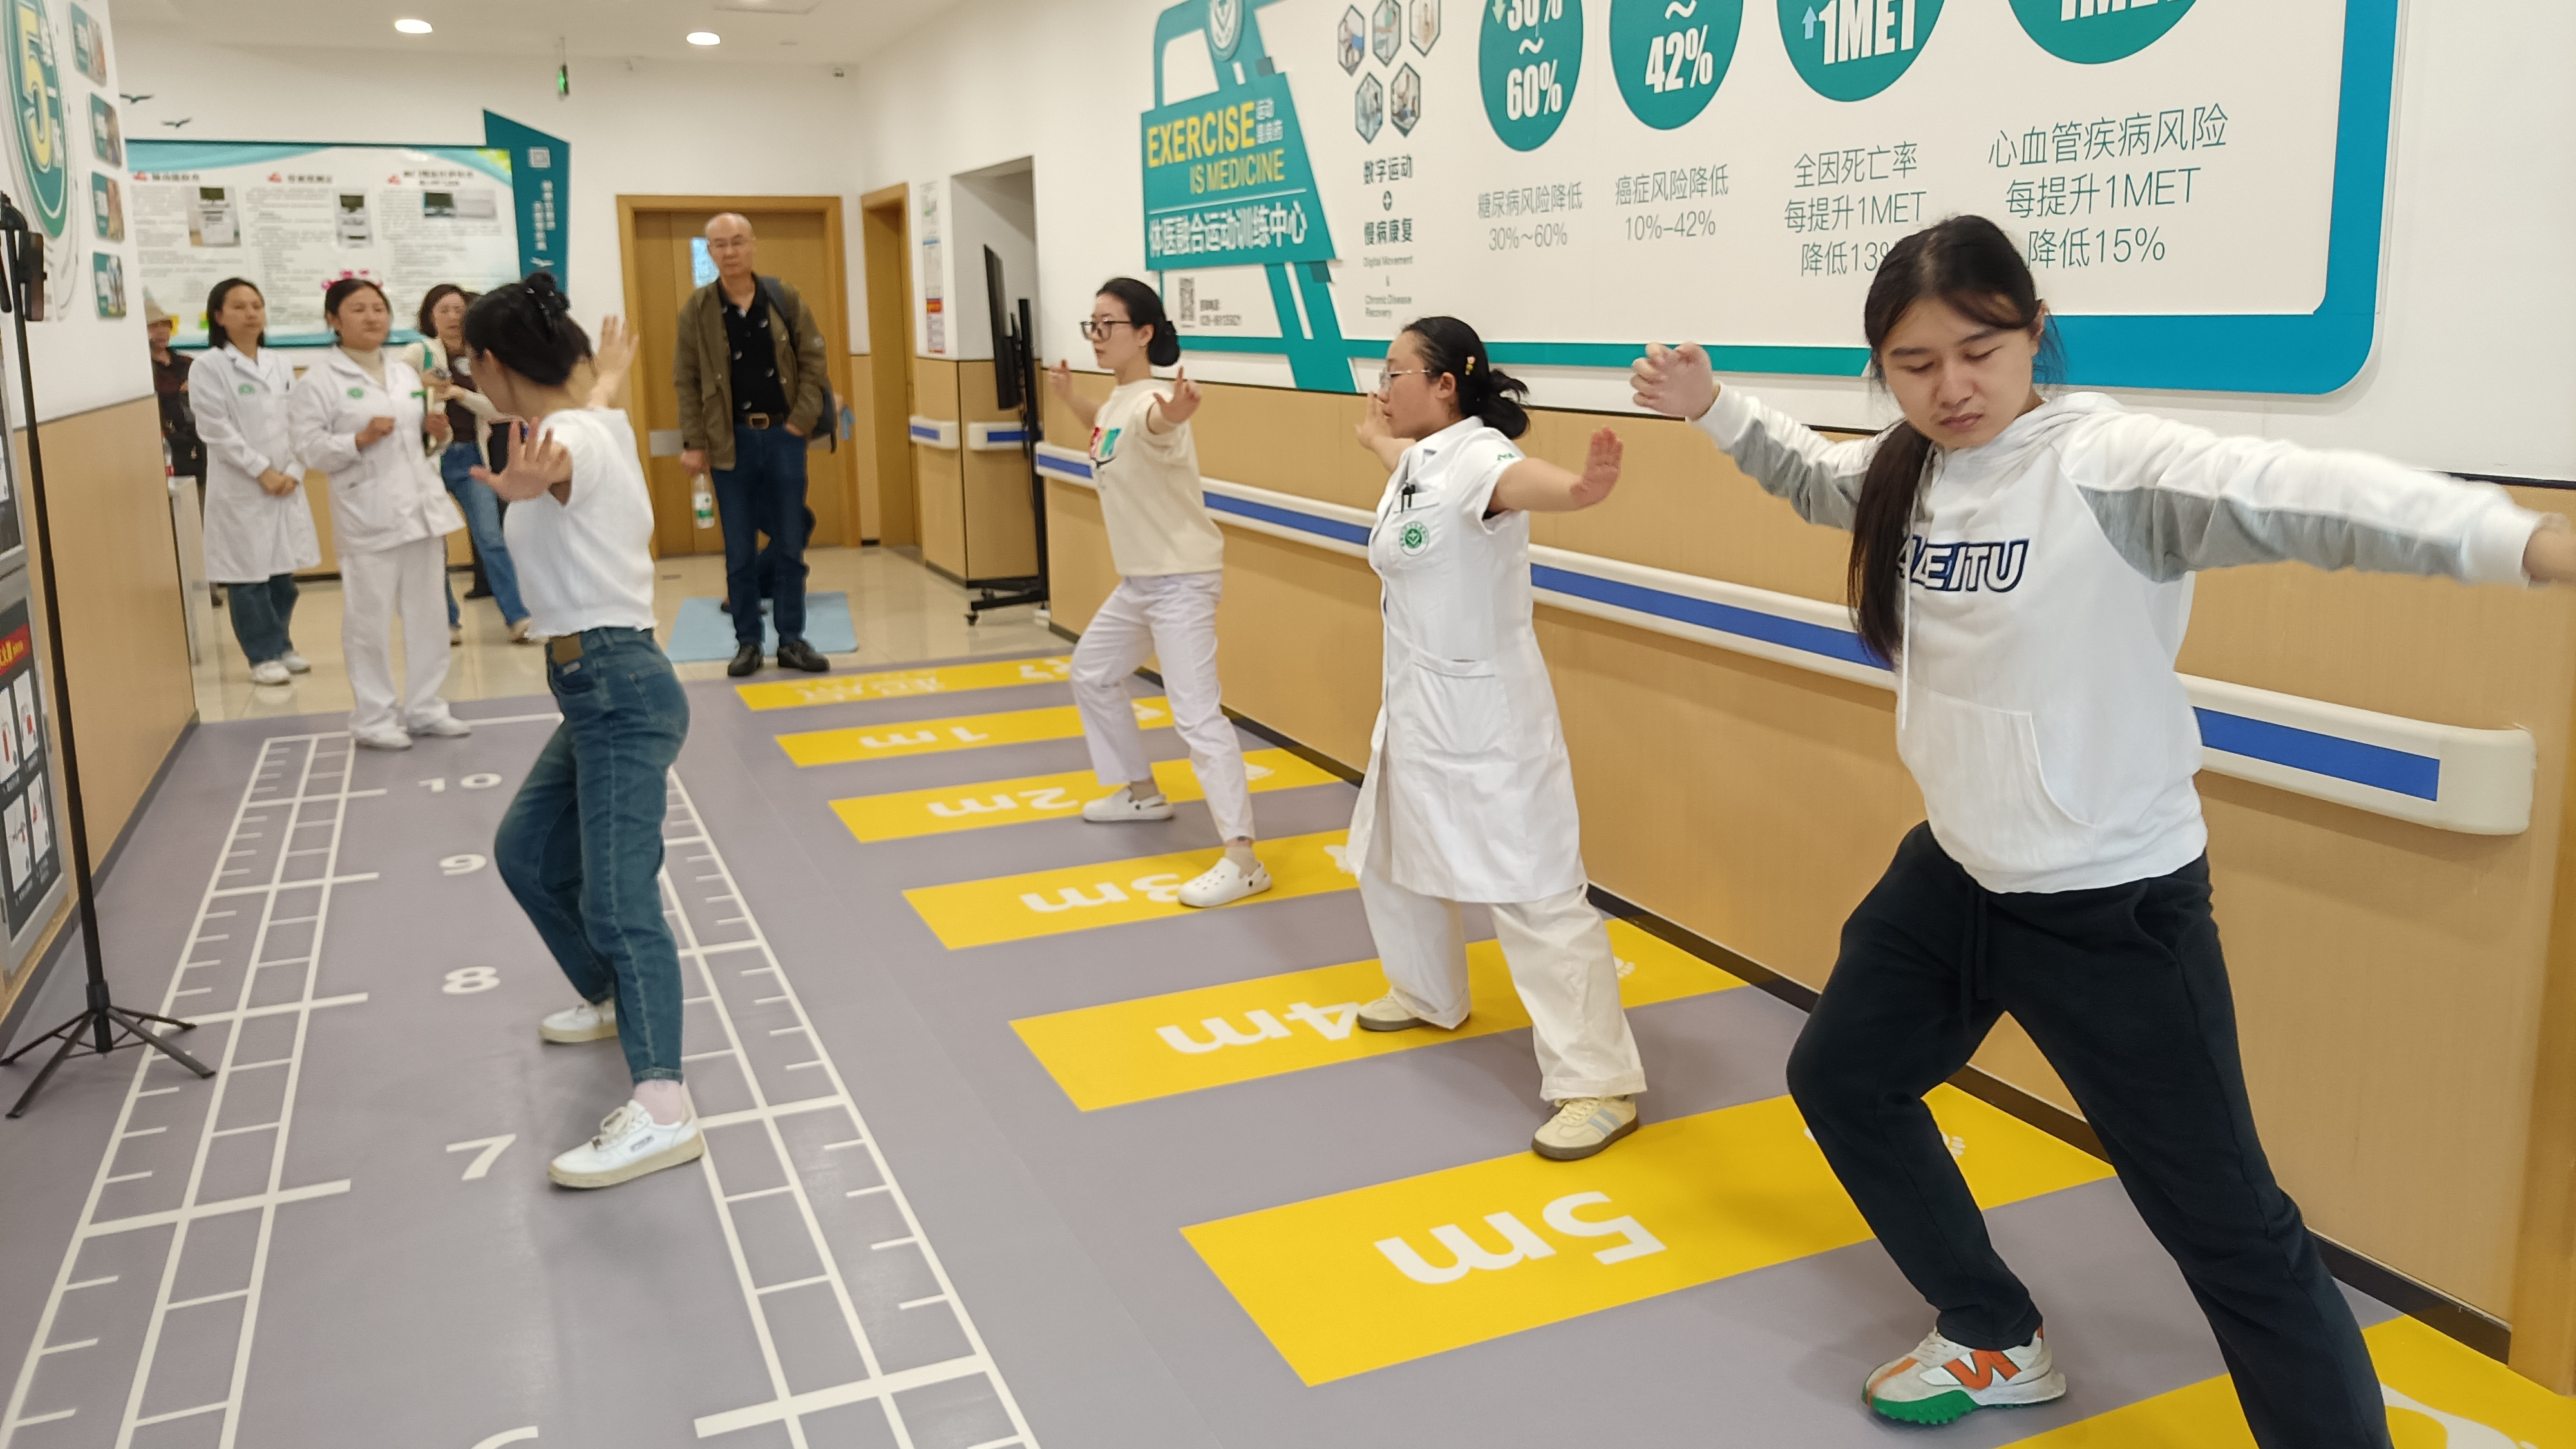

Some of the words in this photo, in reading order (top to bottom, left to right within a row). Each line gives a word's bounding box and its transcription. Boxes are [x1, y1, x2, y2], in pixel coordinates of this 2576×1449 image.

[1645, 24, 1714, 94] 42%
[1506, 58, 1563, 121] 60%
[1147, 100, 1255, 169] EXERCISE
[1988, 103, 2228, 168] 心血管疾病风险
[1189, 164, 1205, 194] IS
[1207, 148, 1285, 192] MEDICINE
[1363, 155, 1413, 185] 数字运动
[1615, 164, 1728, 206] 癌症风险降低
[1794, 140, 1918, 189] 全因死亡率
[1477, 181, 1583, 220] 糖尿病风险降低
[1784, 191, 1927, 233] 每提升1MET
[2005, 167, 2201, 219] 每提升1MET
[2027, 226, 2165, 269] 降低15%
[418, 773, 502, 793] 10
[927, 787, 1079, 817] 2m
[439, 854, 487, 876] 9
[1020, 874, 1180, 913] 3m
[442, 966, 500, 995] 8
[1156, 1001, 1361, 1054] 4m
[446, 1133, 516, 1181] 7
[1374, 1191, 1667, 1284] 5m
